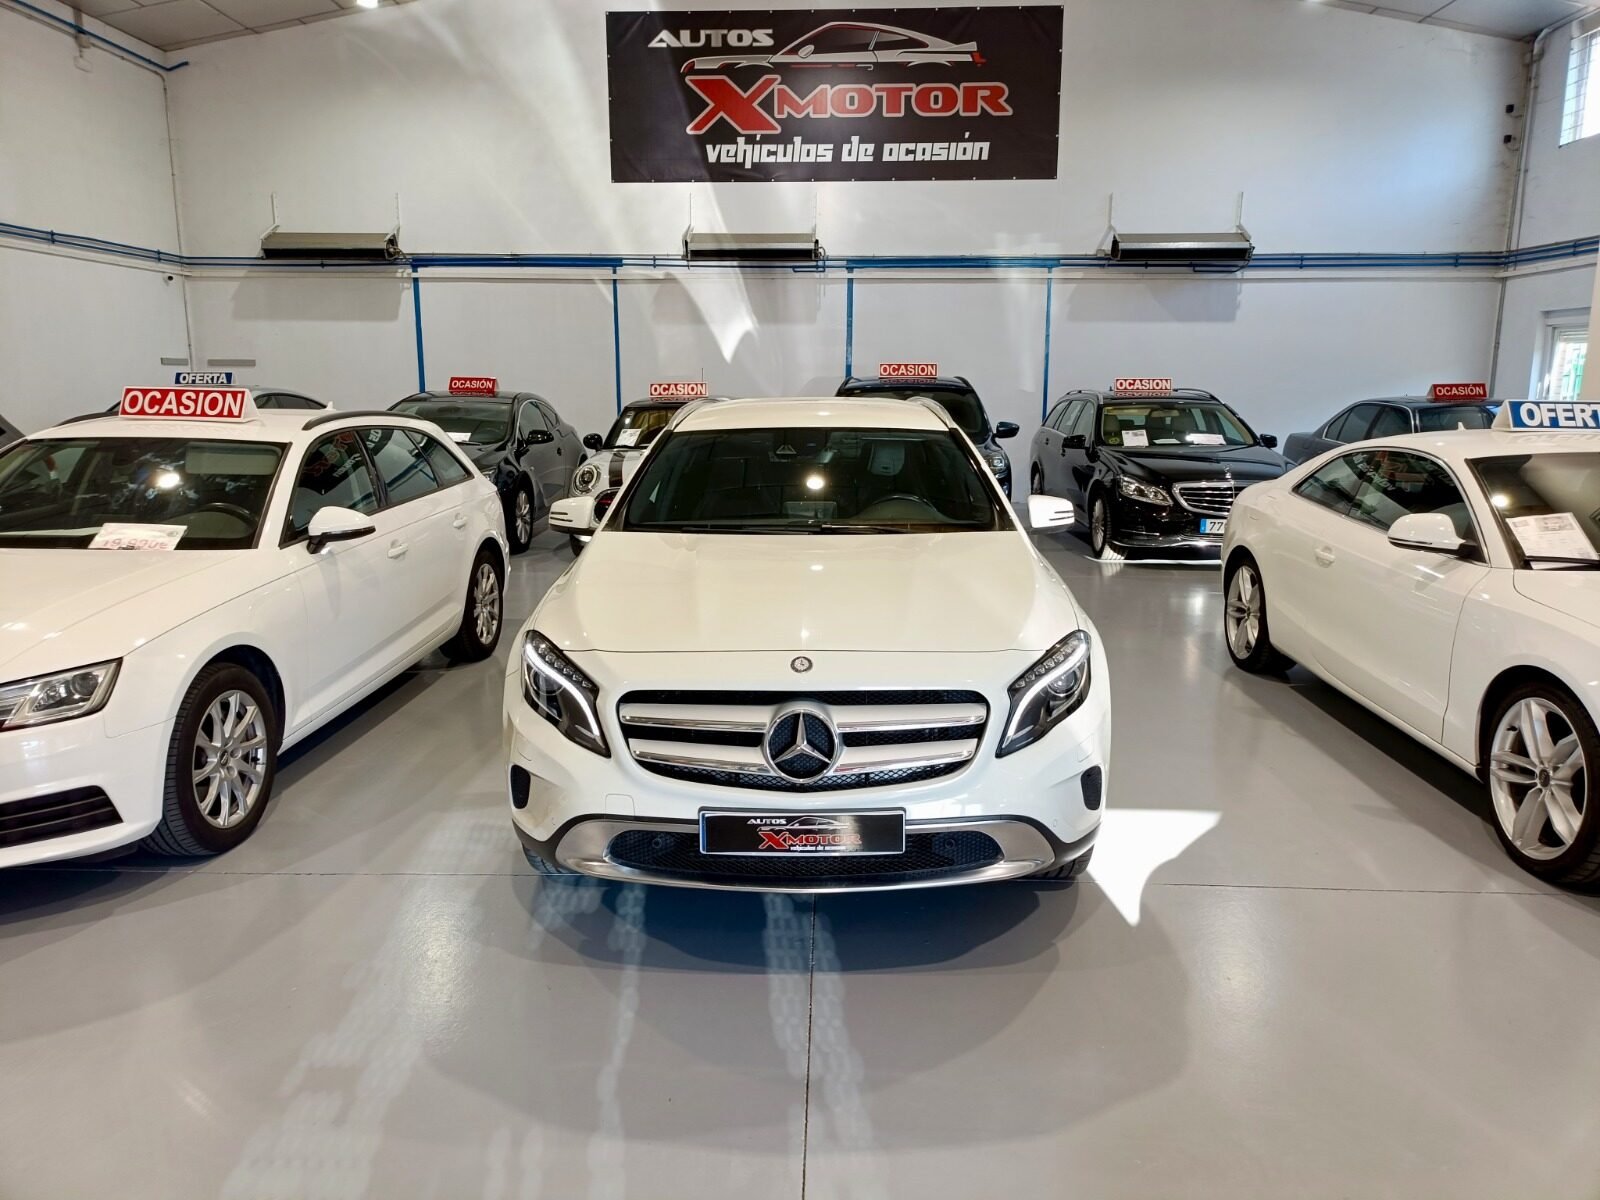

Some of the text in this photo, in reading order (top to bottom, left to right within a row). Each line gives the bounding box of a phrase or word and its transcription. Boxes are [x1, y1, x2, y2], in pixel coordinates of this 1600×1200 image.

[648, 28, 774, 48] AUTOS
[686, 75, 1013, 134] XMOTOR
[706, 132, 989, 169] vehículos de ocasión
[880, 364, 936, 376] OCASION
[179, 373, 227, 385] OFERTA
[451, 379, 493, 390] OCASIÓN
[1116, 379, 1171, 390] OCASION
[651, 384, 706, 395] OCASION
[1436, 384, 1484, 396] OCASIÓN
[123, 390, 243, 416] OCASION
